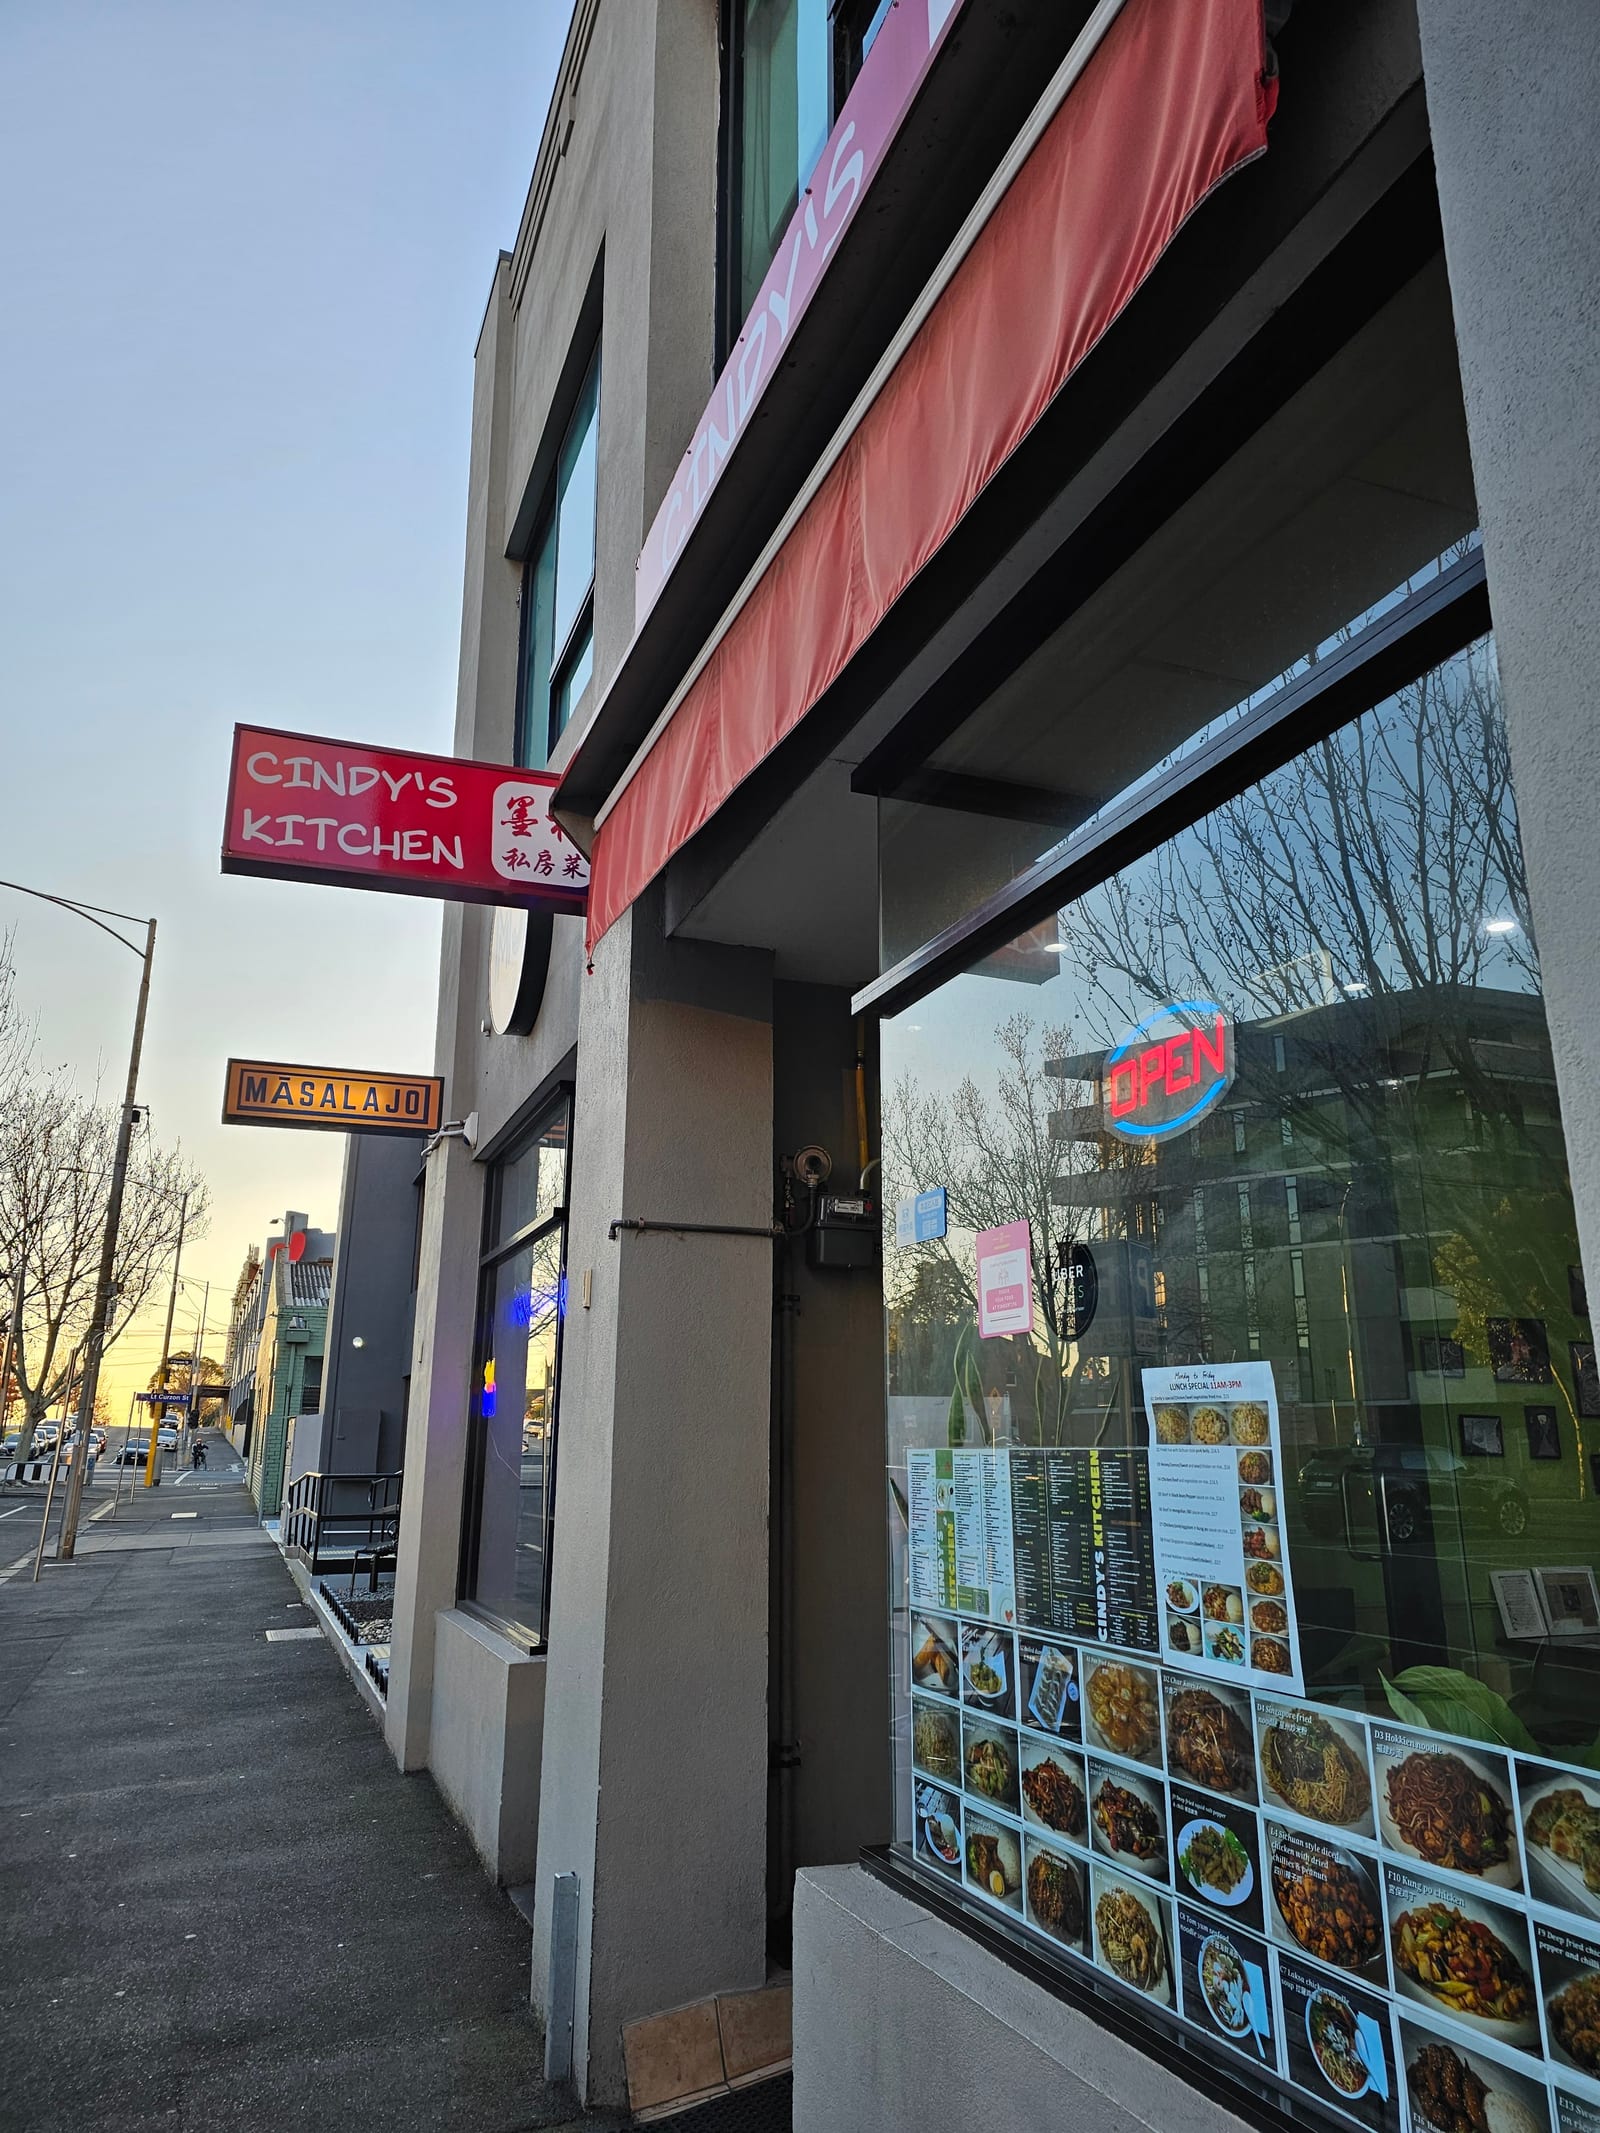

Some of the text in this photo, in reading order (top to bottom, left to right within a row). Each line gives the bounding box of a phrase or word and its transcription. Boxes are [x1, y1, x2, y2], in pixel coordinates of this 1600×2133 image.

[246, 751, 458, 808] CINDY'S
[241, 808, 465, 870] KITCHEN
[501, 847, 588, 880] 私房菜
[1110, 1014, 1225, 1118] OPEN
[1053, 1264, 1084, 1282] UBER
[1169, 1380, 1242, 1391] LUNCH SPECIAL 11AM-3PM
[1089, 1450, 1104, 1547] KITCHEN
[947, 1522, 957, 1609] KITCHEN
[1094, 1551, 1108, 1642] CINDY'S
[1265, 1704, 1297, 1720] Singapore
[1296, 1712, 1313, 1724] fried
[1374, 1729, 1443, 1755] D3 Hokkien noodle
[1271, 1840, 1329, 1869] chicken with dried
[1278, 1830, 1304, 1847] Sichuan
[1304, 1840, 1320, 1852] style
[1321, 1847, 1340, 1859] diced
[1272, 1854, 1328, 1882] chillies & peanuts
[1387, 1870, 1466, 1908] F10 Kung po chicken
[1186, 1914, 1197, 1927] Tom
[1197, 1921, 1209, 1933] yum
[1208, 1928, 1230, 1941] seafood
[1539, 1941, 1564, 1956] pepper
[1564, 1950, 1580, 1962] and
[1547, 1931, 1565, 1946] Deep
[1565, 1937, 1585, 1952] fried
[1281, 1978, 1295, 1991] soup
[1287, 1968, 1305, 1984] Laksa
[1559, 2095, 1574, 2112] E13
[1560, 2114, 1573, 2126] on
